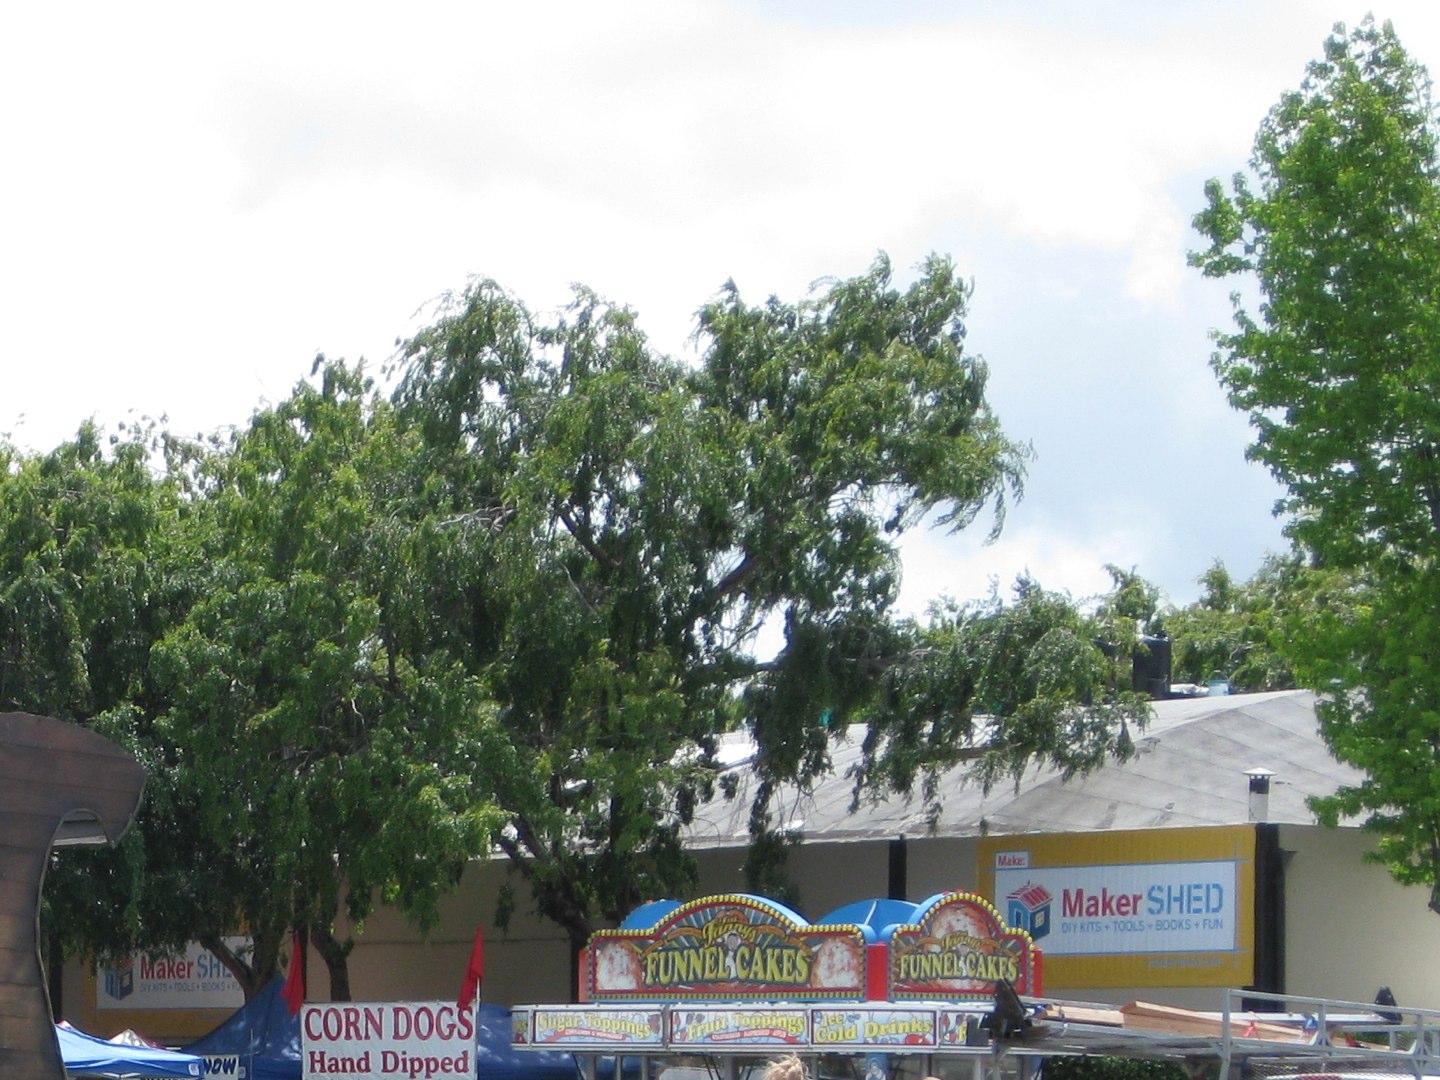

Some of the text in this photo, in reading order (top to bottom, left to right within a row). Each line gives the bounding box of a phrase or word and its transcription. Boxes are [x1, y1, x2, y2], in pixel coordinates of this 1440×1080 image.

[997, 854, 1026, 868] Make:
[1061, 883, 1225, 918] Maker SHED
[1061, 921, 1078, 934] DIY
[1079, 920, 1102, 933] KITS
[1112, 919, 1146, 933] TOOLS
[1155, 918, 1192, 931] BOOKS
[1202, 918, 1224, 930] FUN
[140, 954, 194, 980] Maker
[644, 945, 809, 986] FUNNEL CAKES
[899, 951, 1018, 981] FUNNEL CAKES
[304, 1006, 474, 1041] CORN DOGS
[537, 1011, 583, 1032] Sugar
[584, 1012, 652, 1040] Toppings
[687, 1018, 729, 1042] Fruit
[731, 1012, 806, 1035] Toppings
[815, 1018, 932, 1043] Cold Drinks
[823, 1013, 845, 1027] Ice
[309, 1050, 470, 1079] Hand Dipped
